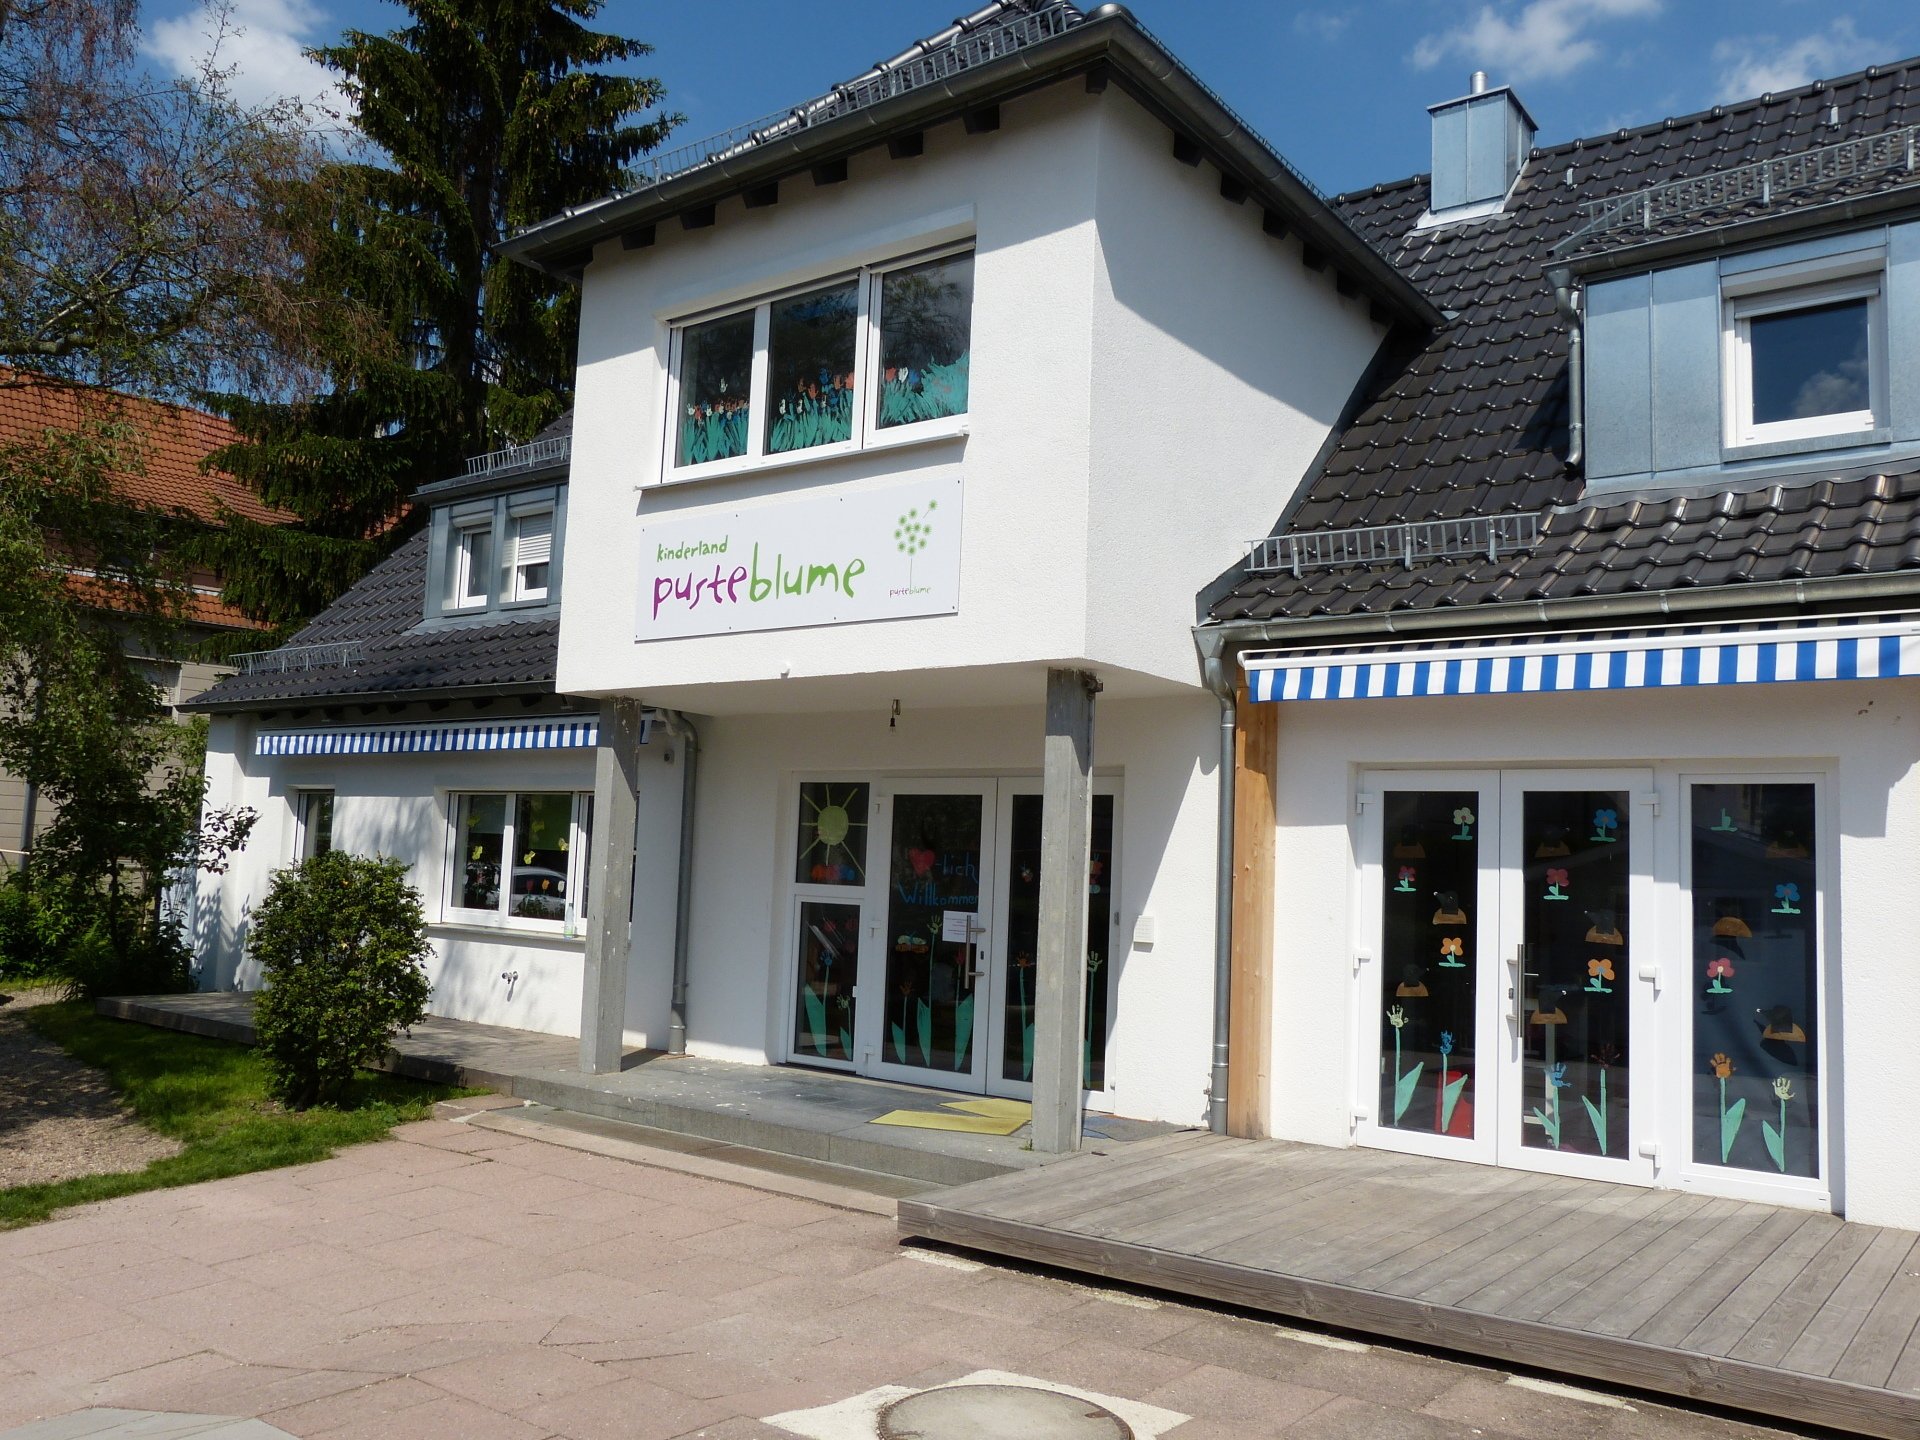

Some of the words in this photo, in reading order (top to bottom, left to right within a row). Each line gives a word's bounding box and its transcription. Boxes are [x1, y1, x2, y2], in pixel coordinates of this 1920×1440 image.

[657, 534, 728, 562] kinderland
[653, 541, 865, 621] pusteblume
[889, 586, 931, 598] pusteblume
